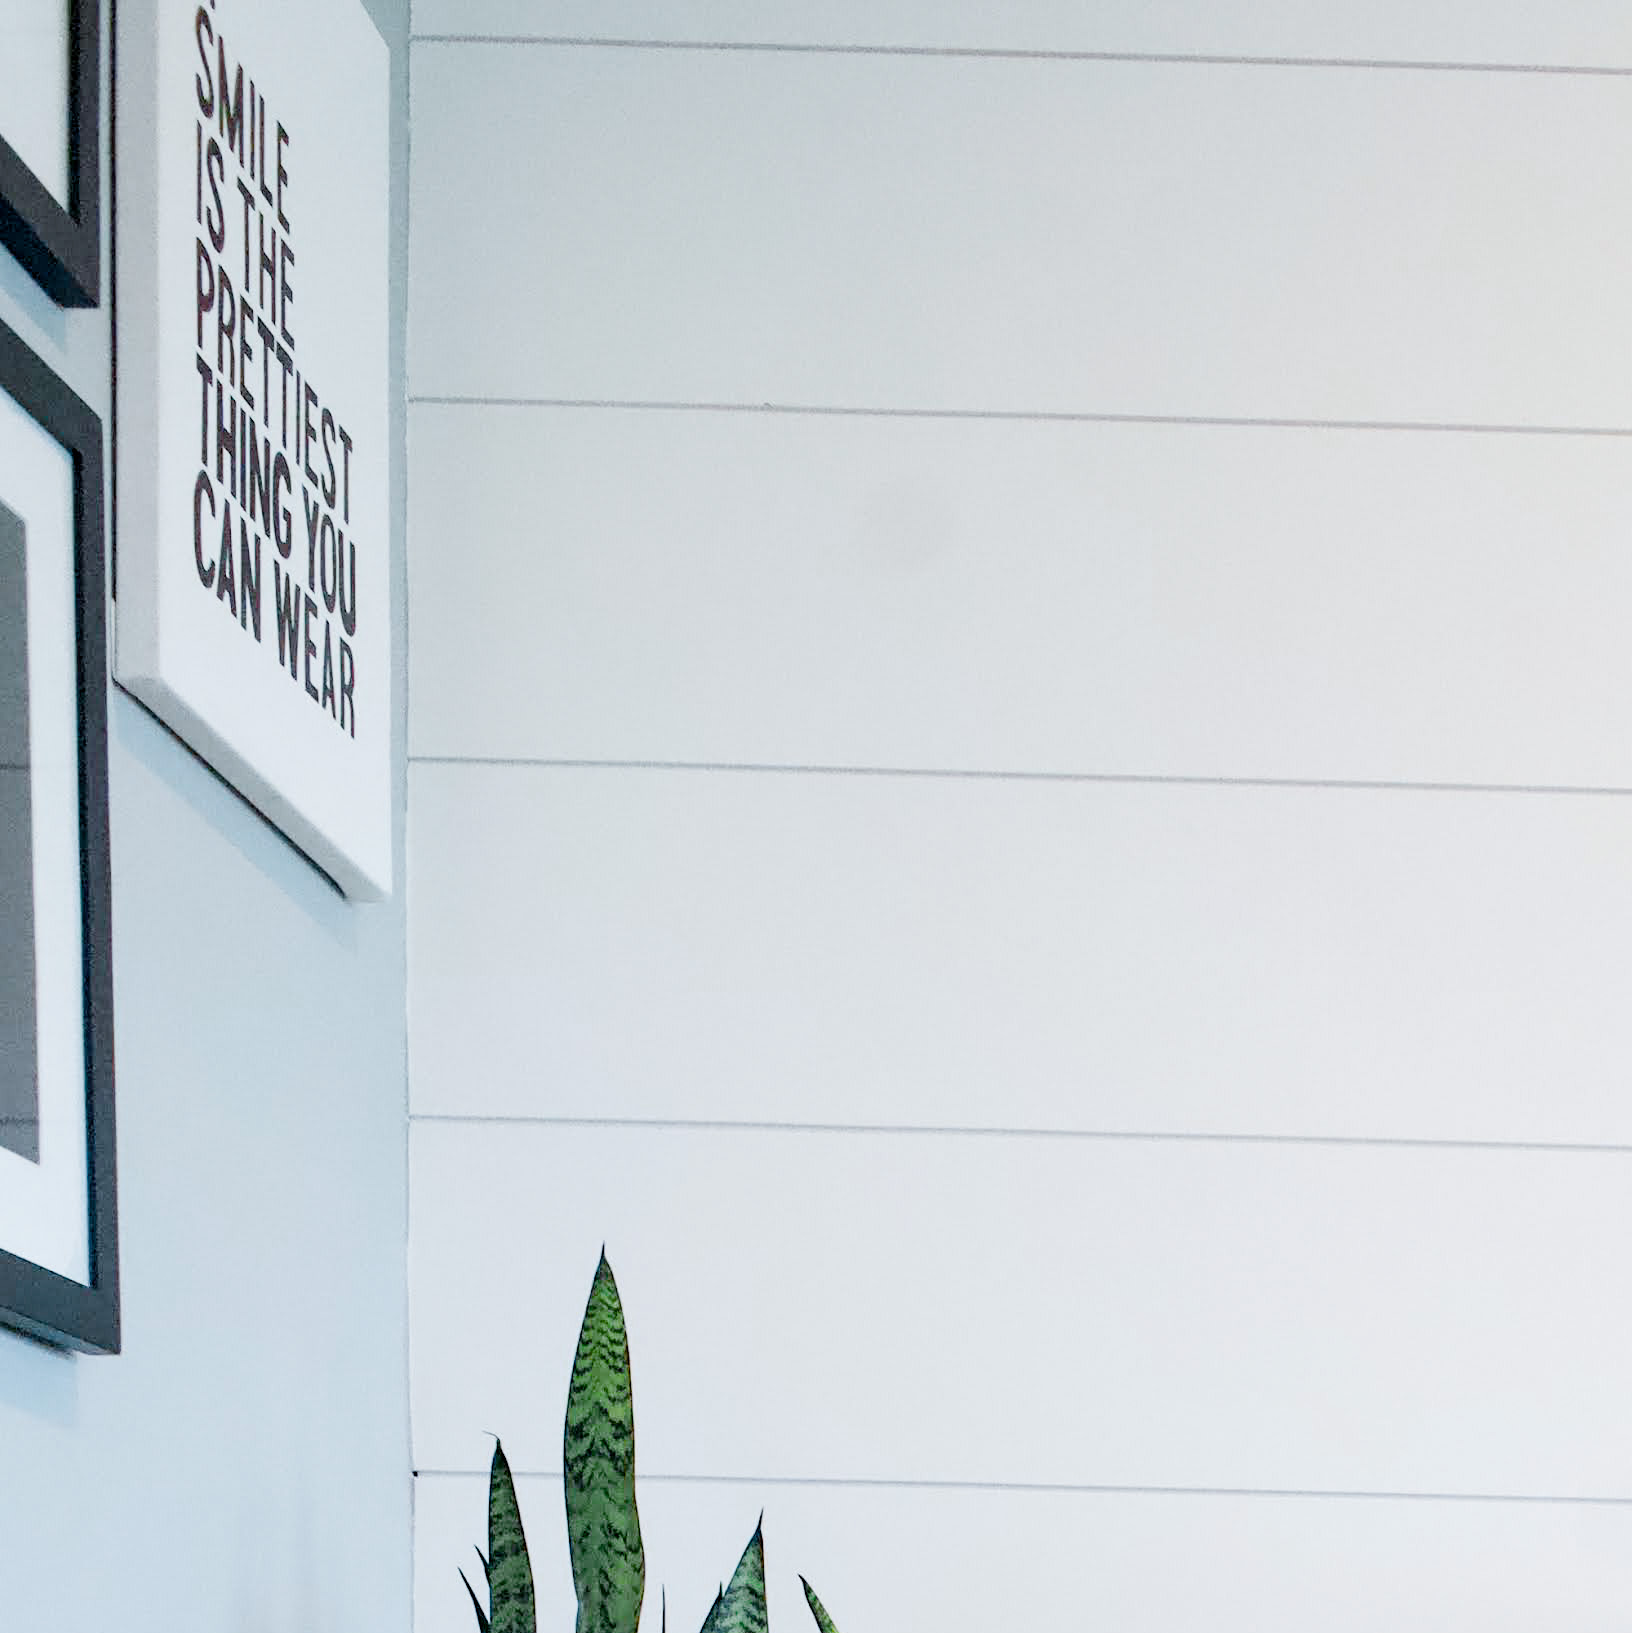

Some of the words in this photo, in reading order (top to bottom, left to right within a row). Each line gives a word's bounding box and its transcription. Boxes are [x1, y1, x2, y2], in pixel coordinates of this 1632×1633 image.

[195, 5, 290, 235] SMILE
[196, 119, 225, 253] IS
[237, 177, 295, 351] THE
[196, 236, 353, 525] PRETTIEST
[196, 352, 292, 559] THING
[302, 483, 356, 637] YOU
[194, 470, 261, 643] CAN
[274, 559, 355, 739] WEAR
